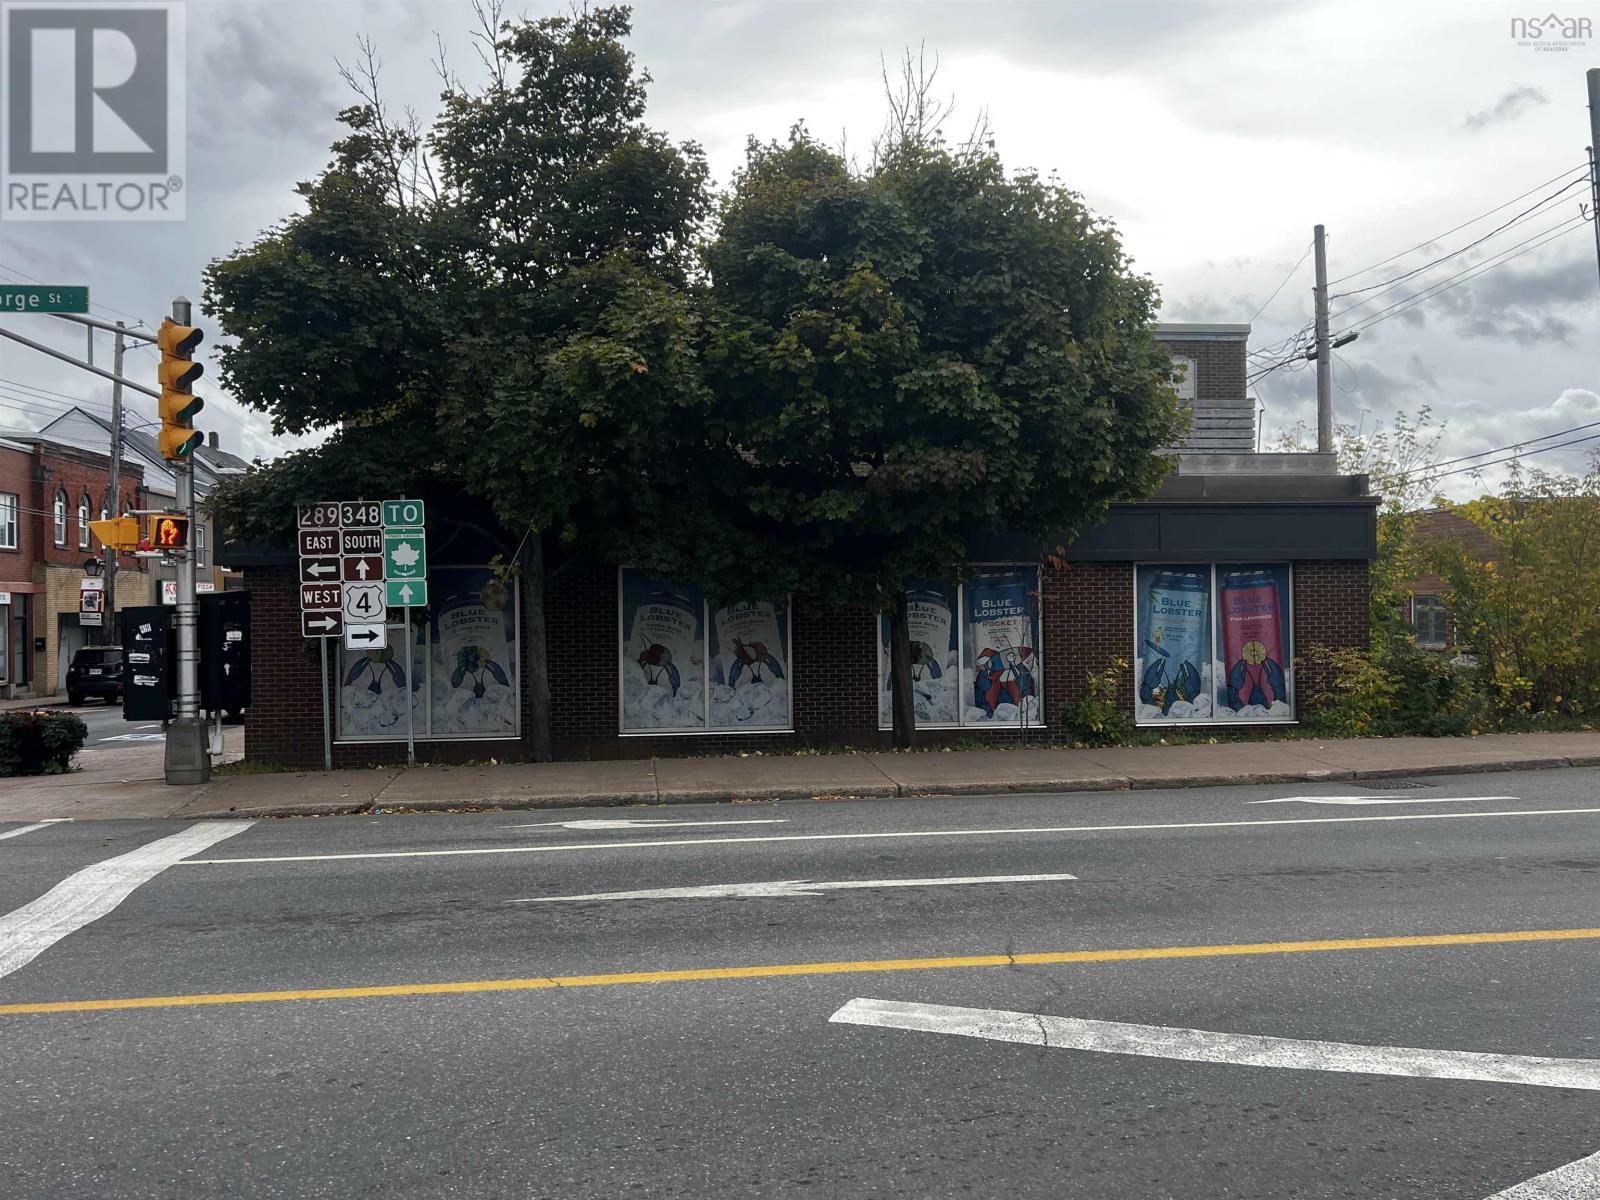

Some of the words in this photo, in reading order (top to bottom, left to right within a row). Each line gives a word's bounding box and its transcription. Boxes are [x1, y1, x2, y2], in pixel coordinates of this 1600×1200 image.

[0, 293, 40, 311] rge
[48, 293, 62, 304] St
[301, 507, 338, 525] 289
[343, 506, 379, 524] 348
[388, 504, 418, 522] TO
[306, 536, 333, 550] EAST
[344, 535, 381, 549] SOUTH
[303, 590, 340, 604] WEST
[356, 592, 372, 613] 4
[981, 599, 1013, 608] BLUE
[1161, 597, 1192, 608] BLUE
[1233, 597, 1264, 606] BLUE
[451, 609, 487, 620] BLUE
[649, 607, 682, 619] BLUE
[721, 610, 771, 626] LOBSTER
[974, 607, 1024, 617] LOBSTER
[1152, 605, 1202, 617] LOBSTER
[444, 615, 498, 631] LOBSTER
[640, 614, 691, 631] LOBSTER
[982, 619, 1017, 627] ROCKET
